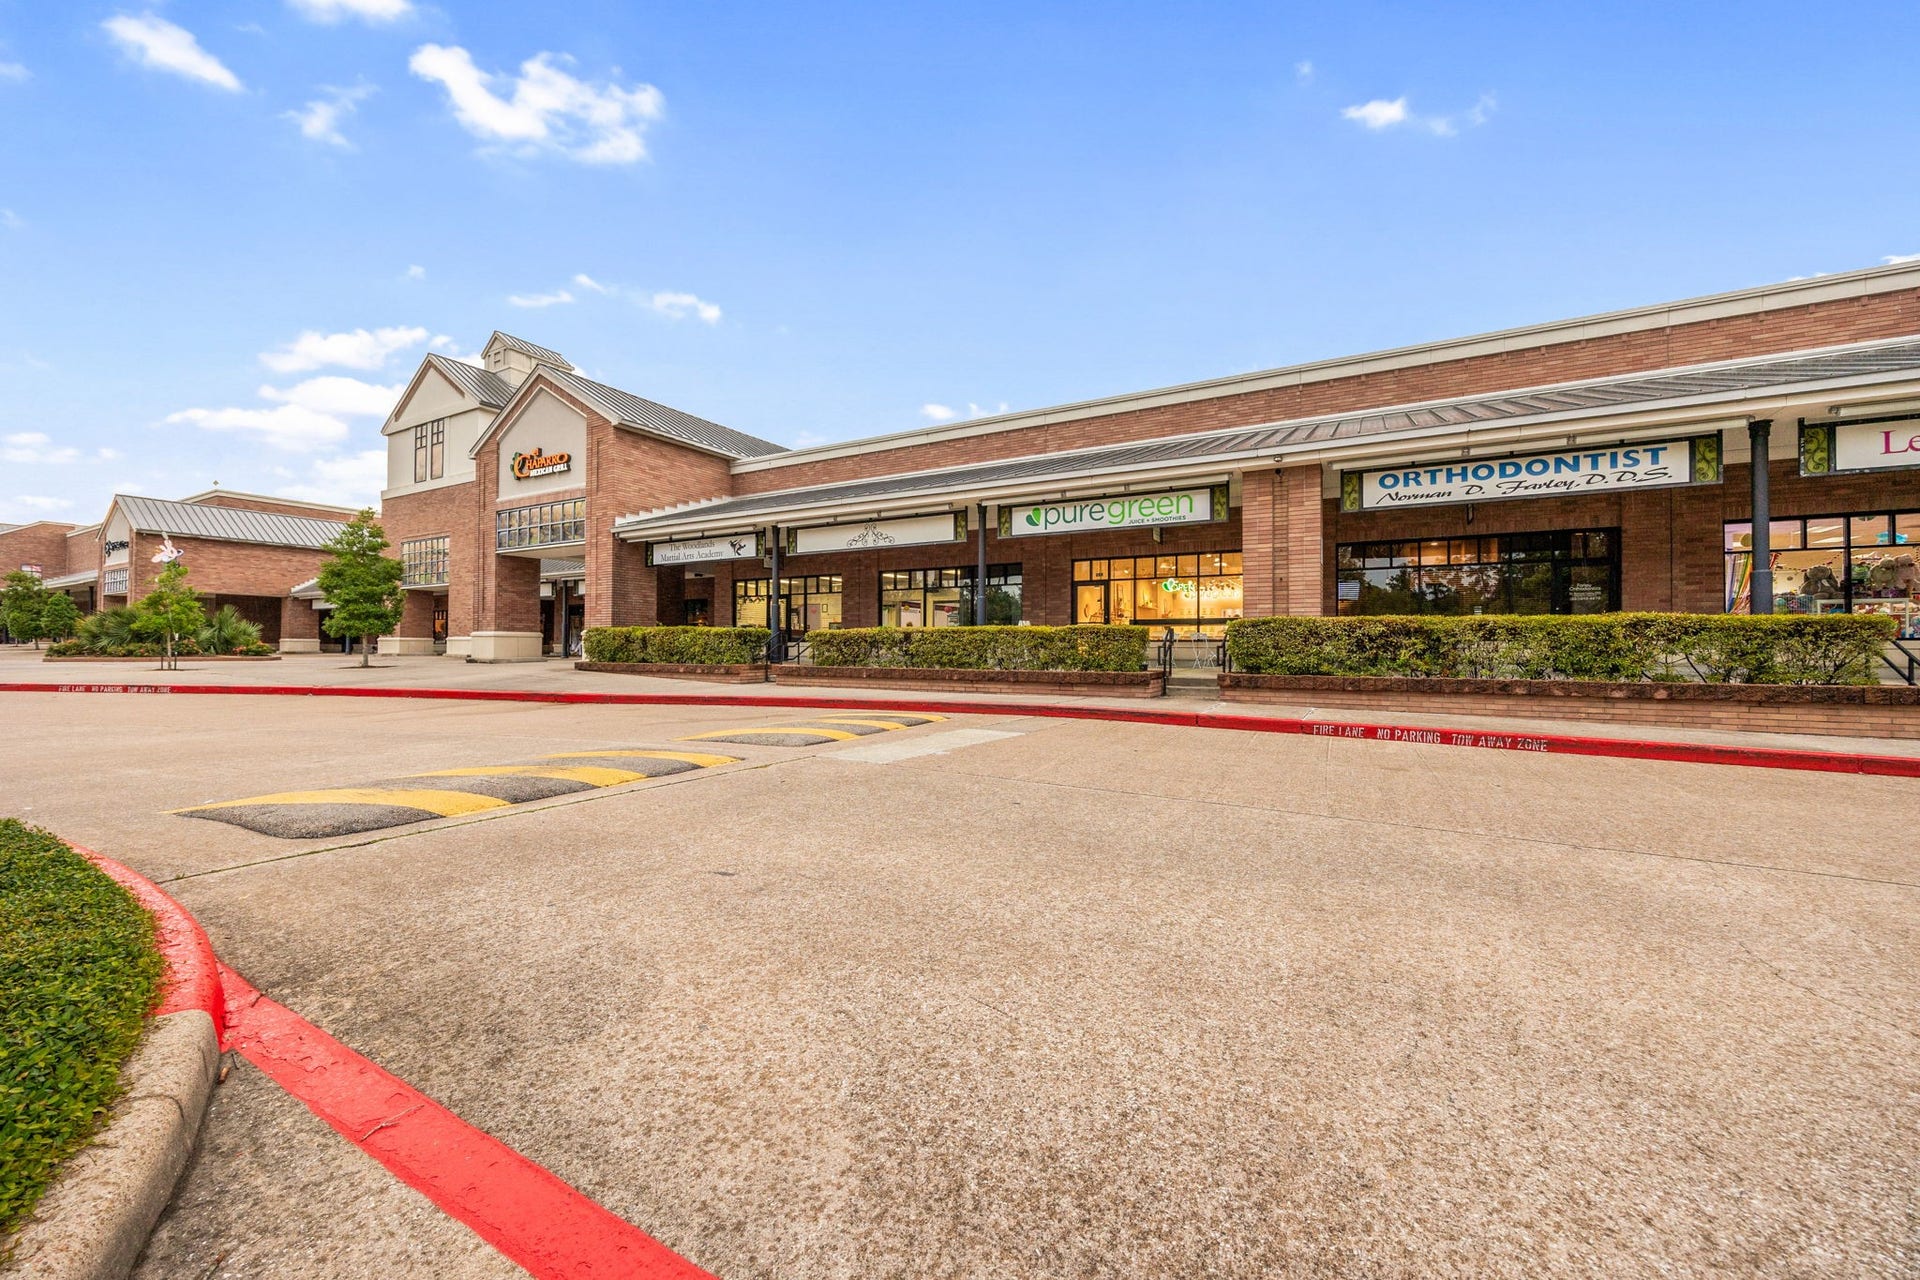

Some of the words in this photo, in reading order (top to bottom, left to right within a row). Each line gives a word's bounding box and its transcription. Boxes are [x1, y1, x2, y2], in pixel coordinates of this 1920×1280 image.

[1378, 447, 1668, 489] ORTHODONTIST
[1376, 491, 1452, 505] Norman
[1460, 484, 1486, 496] D.
[1151, 515, 1187, 523] SMOOTHIES
[669, 543, 682, 552] The
[683, 540, 716, 551] Woodlands
[660, 553, 681, 563] Martial
[682, 552, 695, 561] Arts
[696, 550, 723, 560] Academy
[1313, 724, 1335, 736] FIRE
[1376, 728, 1390, 740] NO
[1394, 729, 1441, 744] PARKING
[1452, 733, 1474, 747] TOW
[1478, 735, 1512, 749] AWAY
[1517, 737, 1548, 752] ZONE
